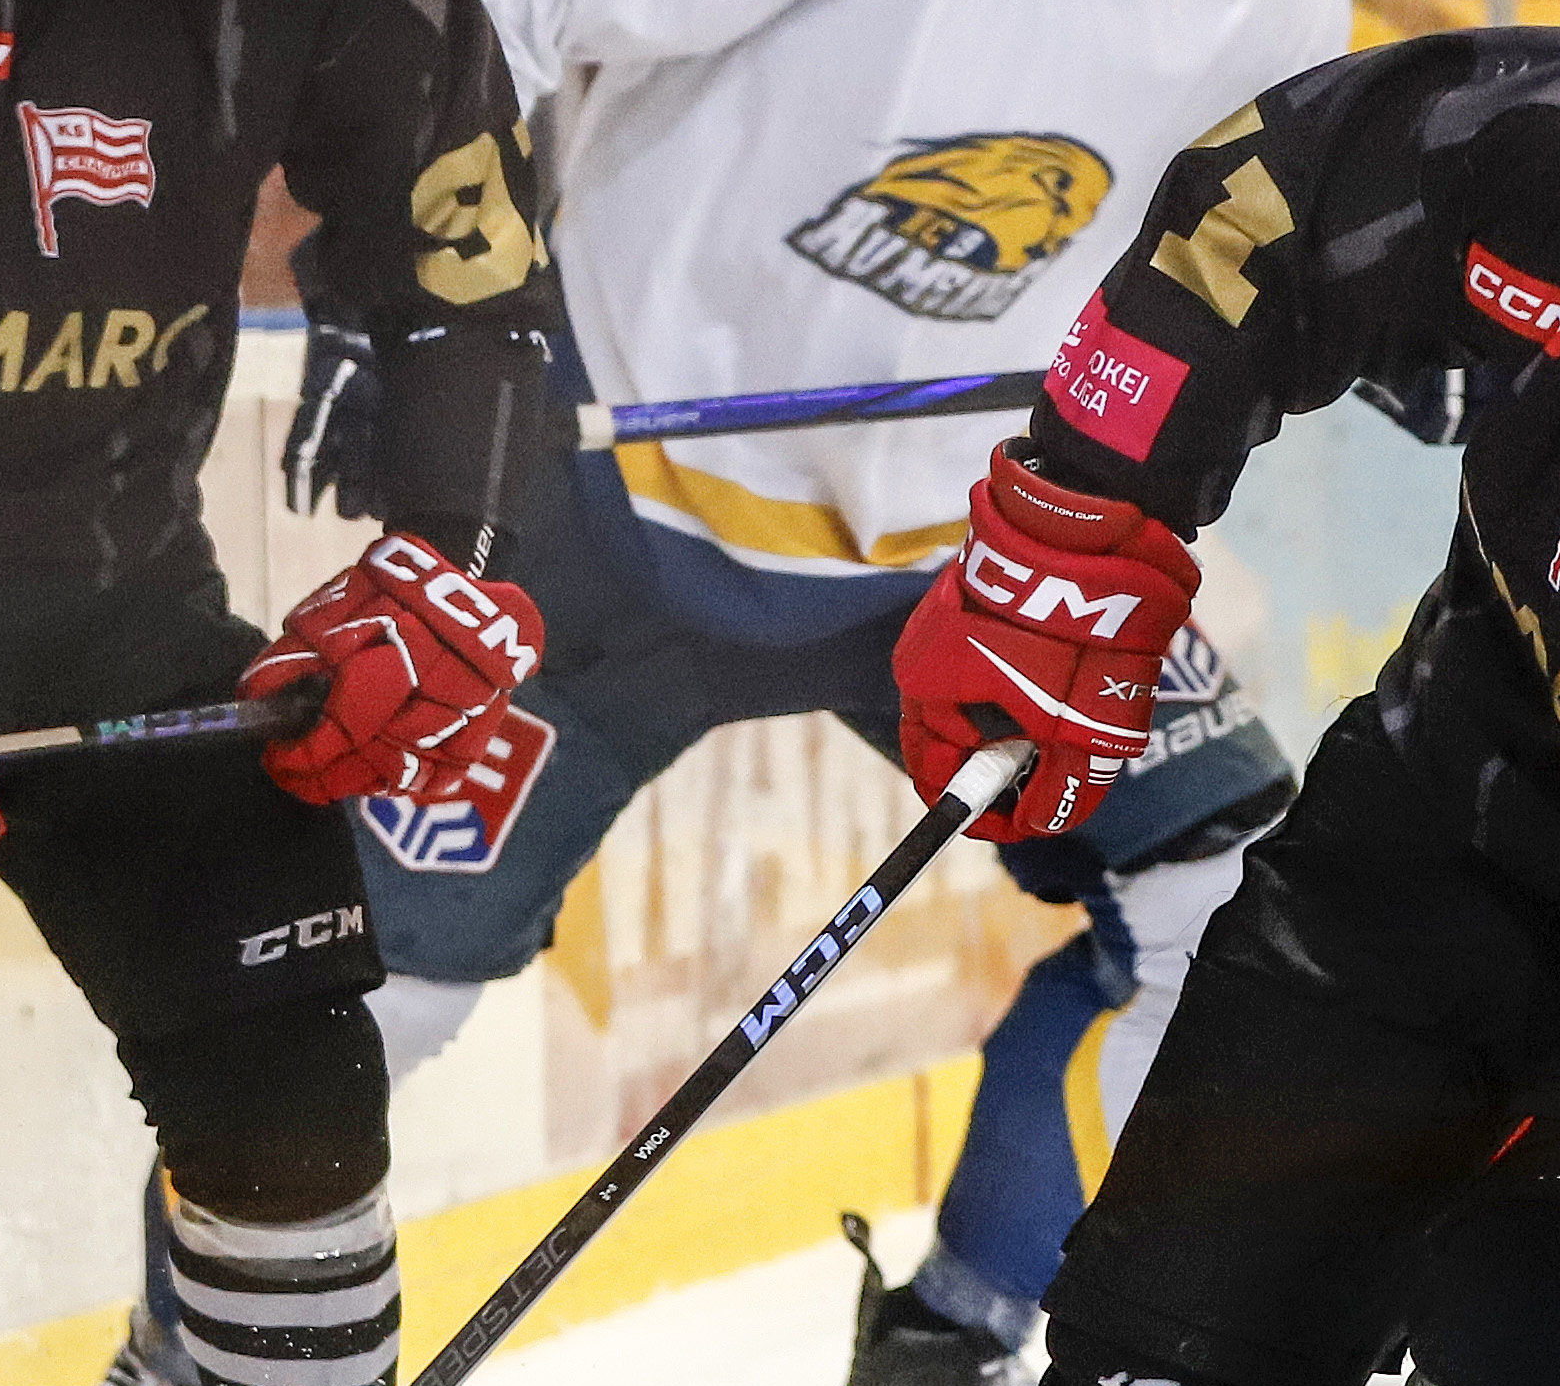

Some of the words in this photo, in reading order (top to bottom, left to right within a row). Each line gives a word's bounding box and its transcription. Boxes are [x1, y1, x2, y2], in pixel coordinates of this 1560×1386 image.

[1069, 375, 1109, 418] LIGA
[1088, 349, 1151, 407] OKEJ
[369, 534, 538, 684] CCM
[959, 525, 1142, 640] CM
[1047, 774, 1082, 831] CCM
[238, 904, 365, 967] CCM
[739, 884, 885, 1051] CCM
